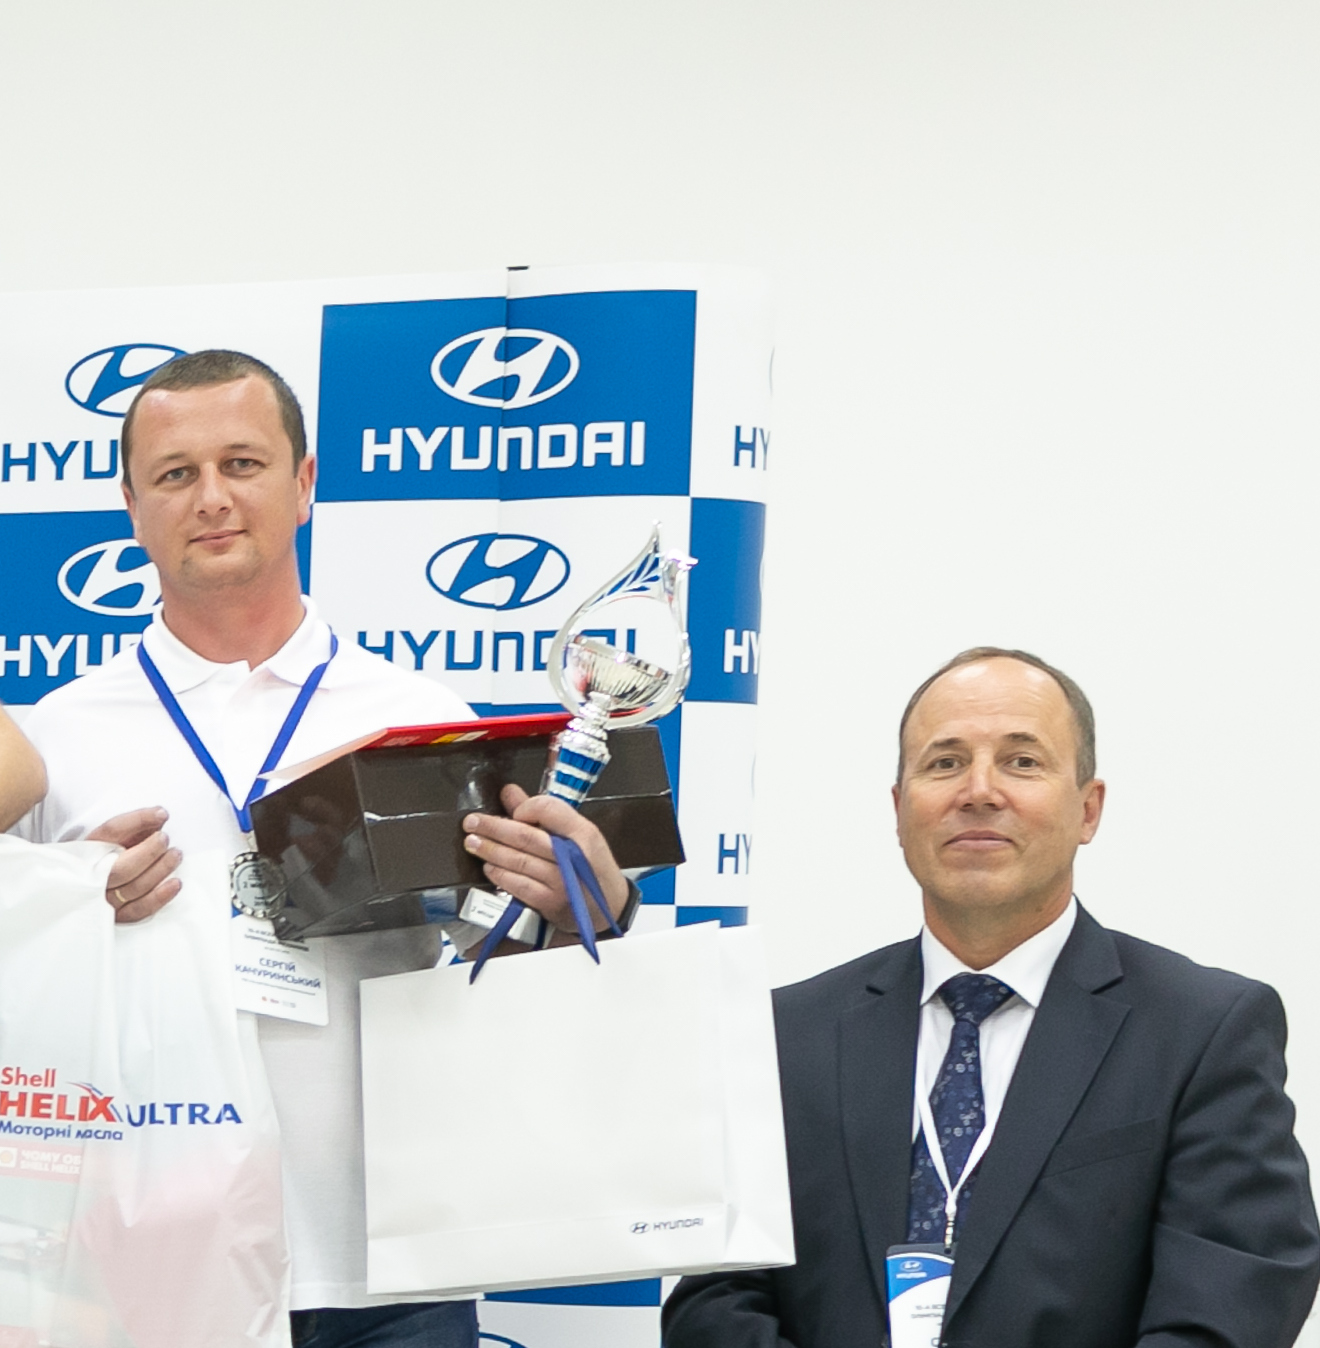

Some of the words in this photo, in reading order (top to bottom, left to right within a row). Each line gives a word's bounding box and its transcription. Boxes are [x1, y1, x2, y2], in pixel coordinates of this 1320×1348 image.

[361, 421, 646, 473] HYUNDAI
[0, 1067, 56, 1088] Shell
[126, 1102, 243, 1127] ULTRA
[653, 1217, 704, 1231] HYUNDAI
